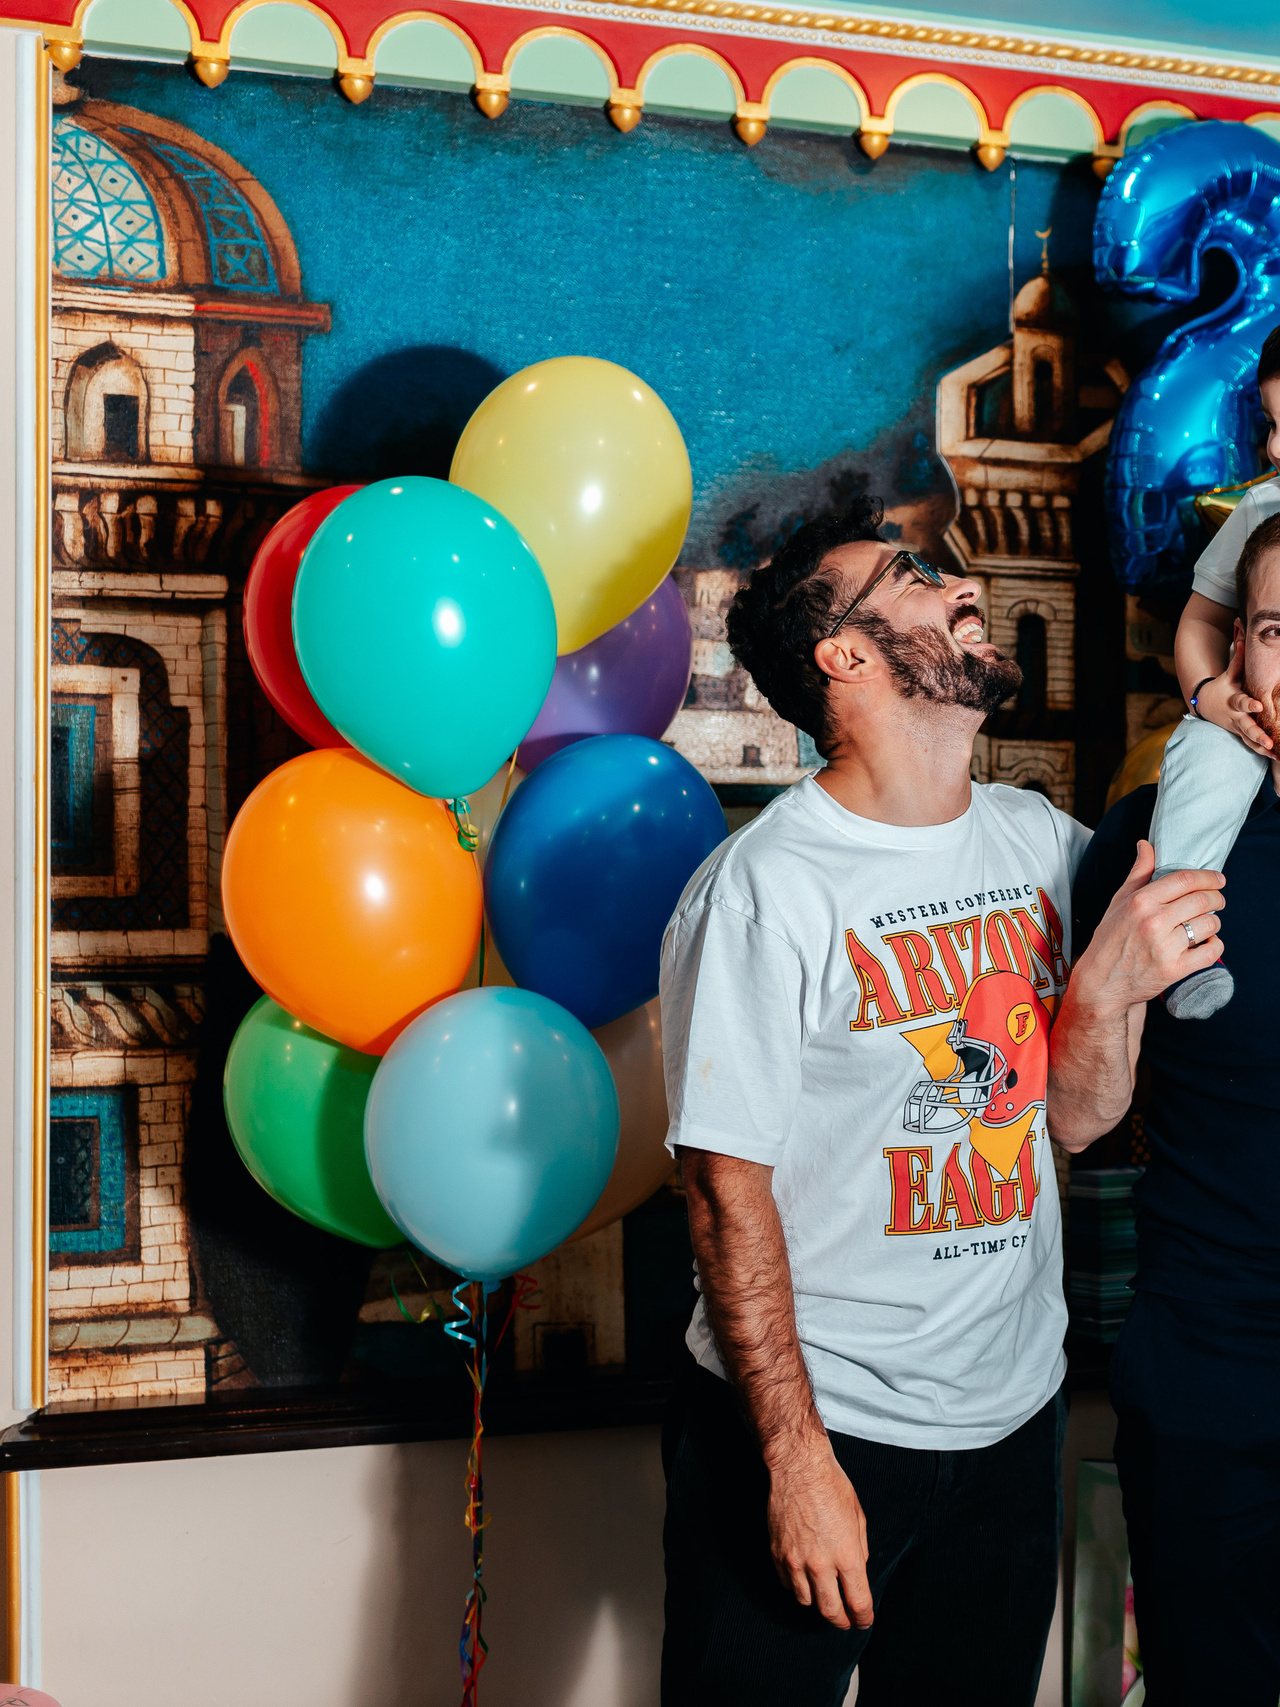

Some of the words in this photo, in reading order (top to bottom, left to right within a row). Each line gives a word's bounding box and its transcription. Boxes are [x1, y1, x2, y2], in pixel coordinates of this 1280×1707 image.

[870, 901, 949, 928] WESTERN
[883, 1127, 1045, 1236] EAGL
[933, 1238, 1006, 1260] ALL-TIME
